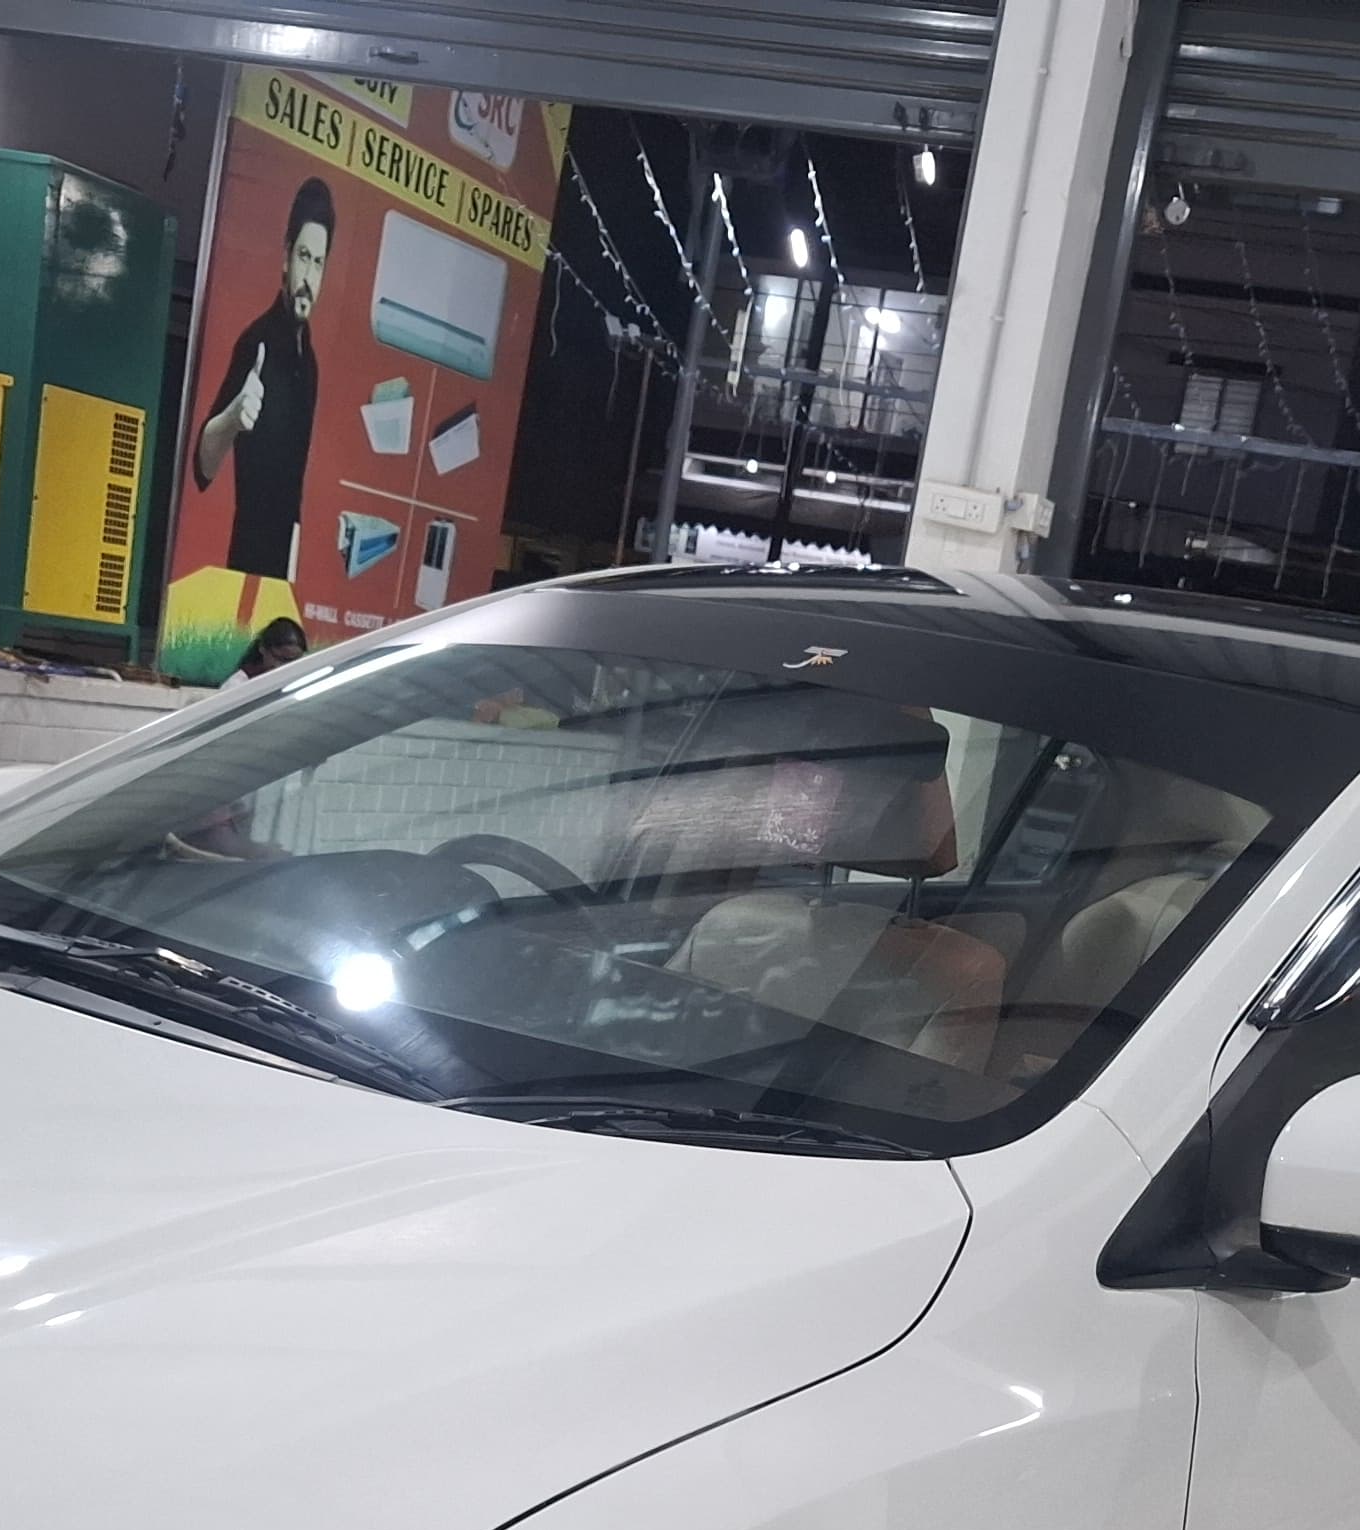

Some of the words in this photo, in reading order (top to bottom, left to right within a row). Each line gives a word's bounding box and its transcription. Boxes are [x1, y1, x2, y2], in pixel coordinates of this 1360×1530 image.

[265, 77, 343, 150] SALES
[361, 128, 452, 208] SERVICE
[467, 187, 533, 253] SPARES
